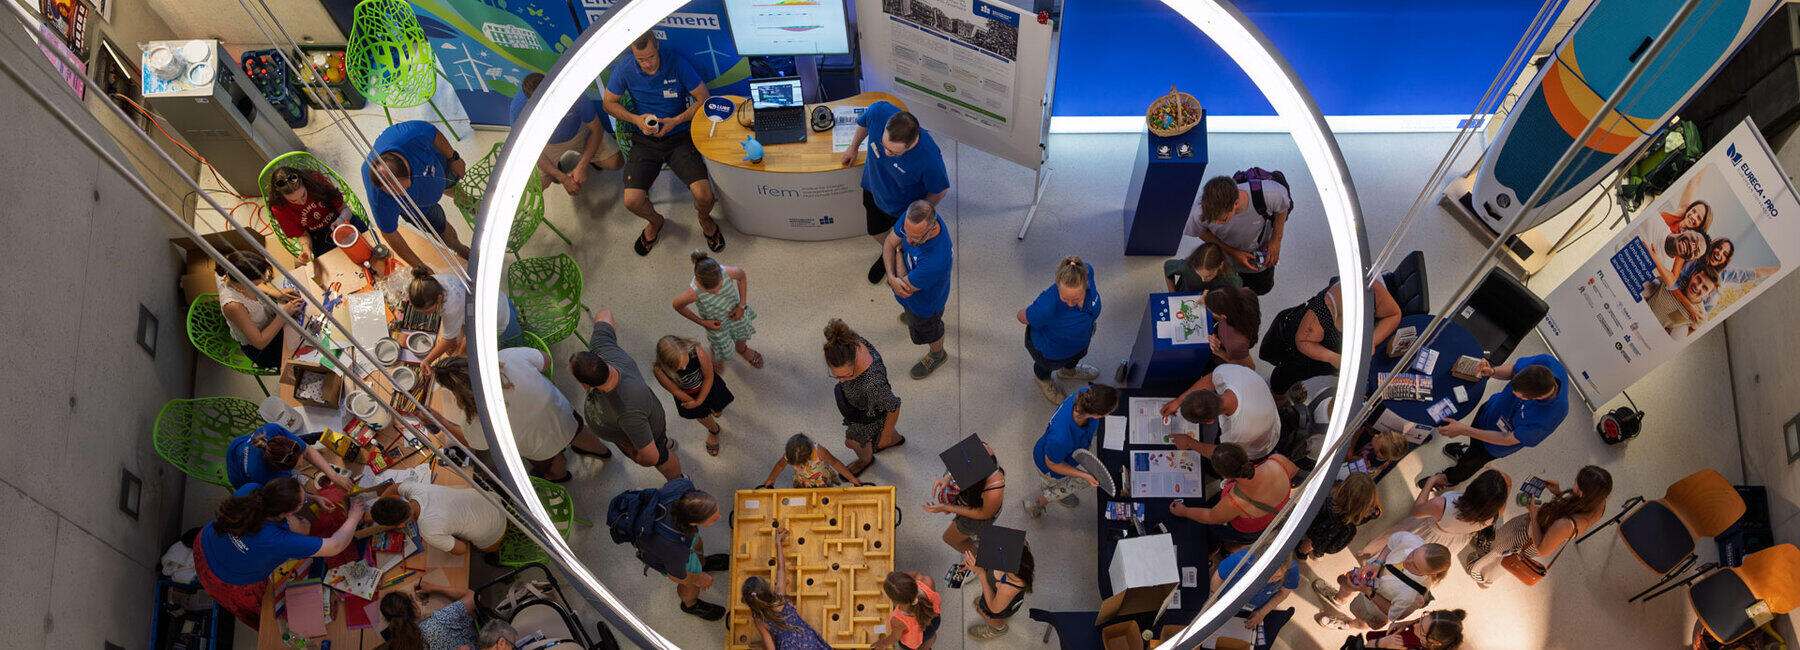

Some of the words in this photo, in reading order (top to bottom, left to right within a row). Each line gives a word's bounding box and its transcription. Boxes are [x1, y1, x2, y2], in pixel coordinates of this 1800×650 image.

[757, 184, 800, 198] ifem
[1740, 163, 1764, 196] EURECA
[1764, 199, 1779, 218] PRO
[1624, 248, 1645, 281] Responsible
[1629, 243, 1647, 271] University
[1645, 270, 1653, 279] on
[1635, 239, 1653, 266] European
[1612, 258, 1620, 270] and
[1619, 268, 1640, 299] Production
[1618, 253, 1642, 290] Consumption
